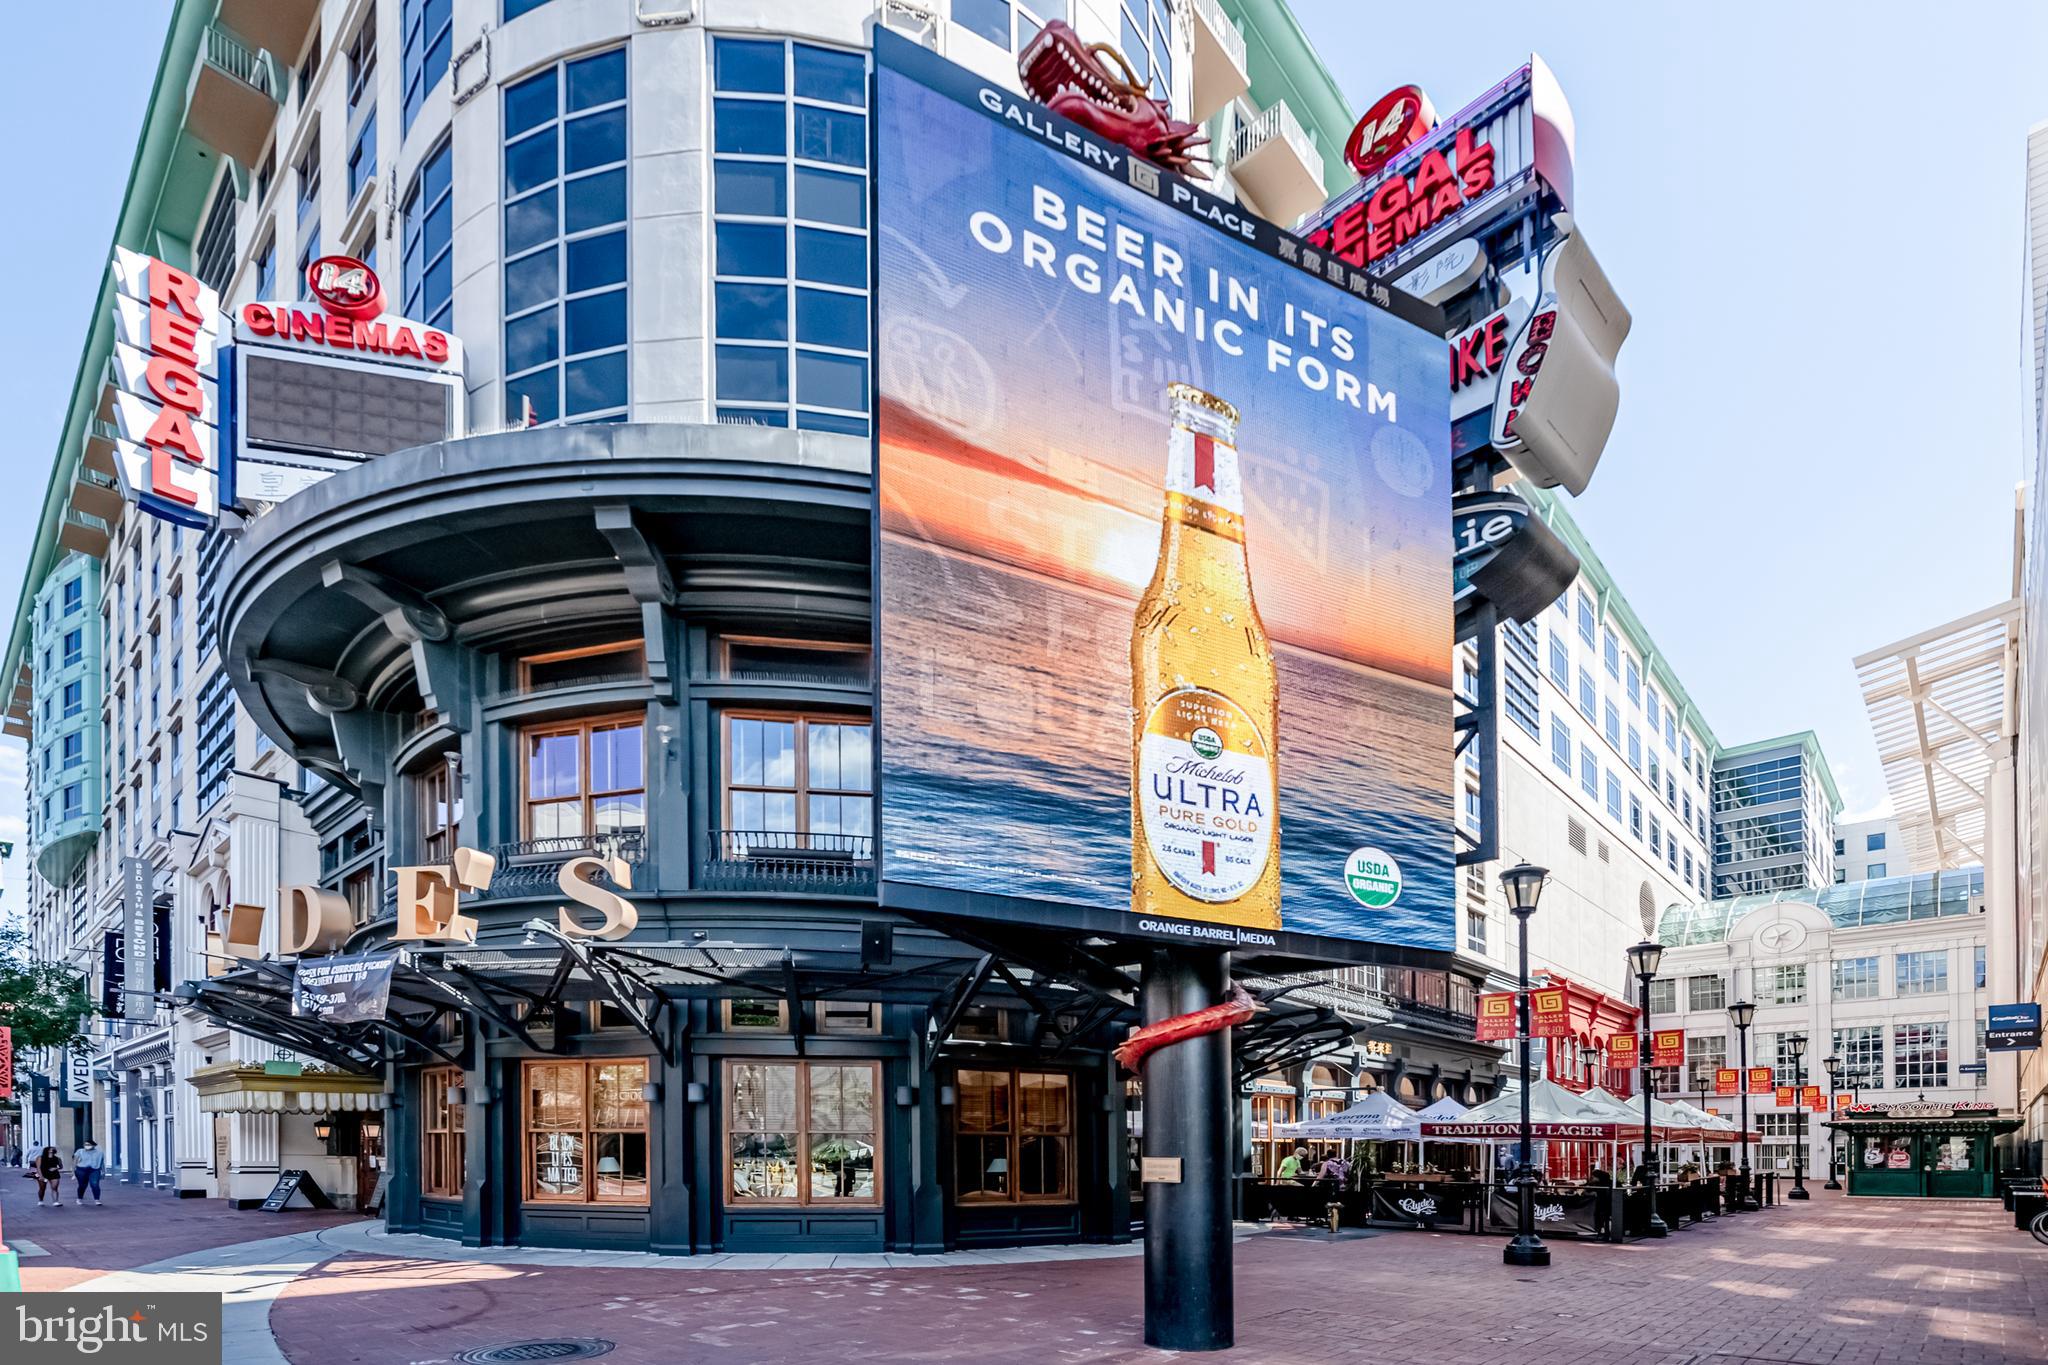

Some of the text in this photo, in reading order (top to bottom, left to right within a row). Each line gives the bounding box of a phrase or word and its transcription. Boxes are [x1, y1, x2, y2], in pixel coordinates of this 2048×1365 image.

[1360, 99, 1406, 157] 14
[978, 88, 1256, 241] GALLERY PLACE
[318, 262, 367, 297] 14
[1033, 185, 1355, 362] BEER IN ITS
[969, 210, 1397, 424] ORGANIC FORM
[243, 303, 449, 364] CINEMAS
[145, 255, 205, 506] REGAL
[1166, 756, 1245, 785] Michelob
[1154, 773, 1262, 817] ULTRA
[1160, 805, 1258, 832] PURE GOLD
[1357, 859, 1389, 878] USDA
[1352, 877, 1395, 895] ORGANIC
[133, 919, 146, 957] BEYOND
[1138, 918, 1276, 946] ORANGE BARREL MEDIA
[334, 973, 353, 983] DAILY
[364, 960, 391, 970] PICKUP
[1989, 1031, 2034, 1039] Entrance
[1877, 1102, 1953, 1111] SMOOTHIE
[1432, 1125, 1603, 1136] TRADITIONL LAGER
[547, 1168, 578, 1182] MATER
[1398, 1198, 1436, 1215] Clyde's
